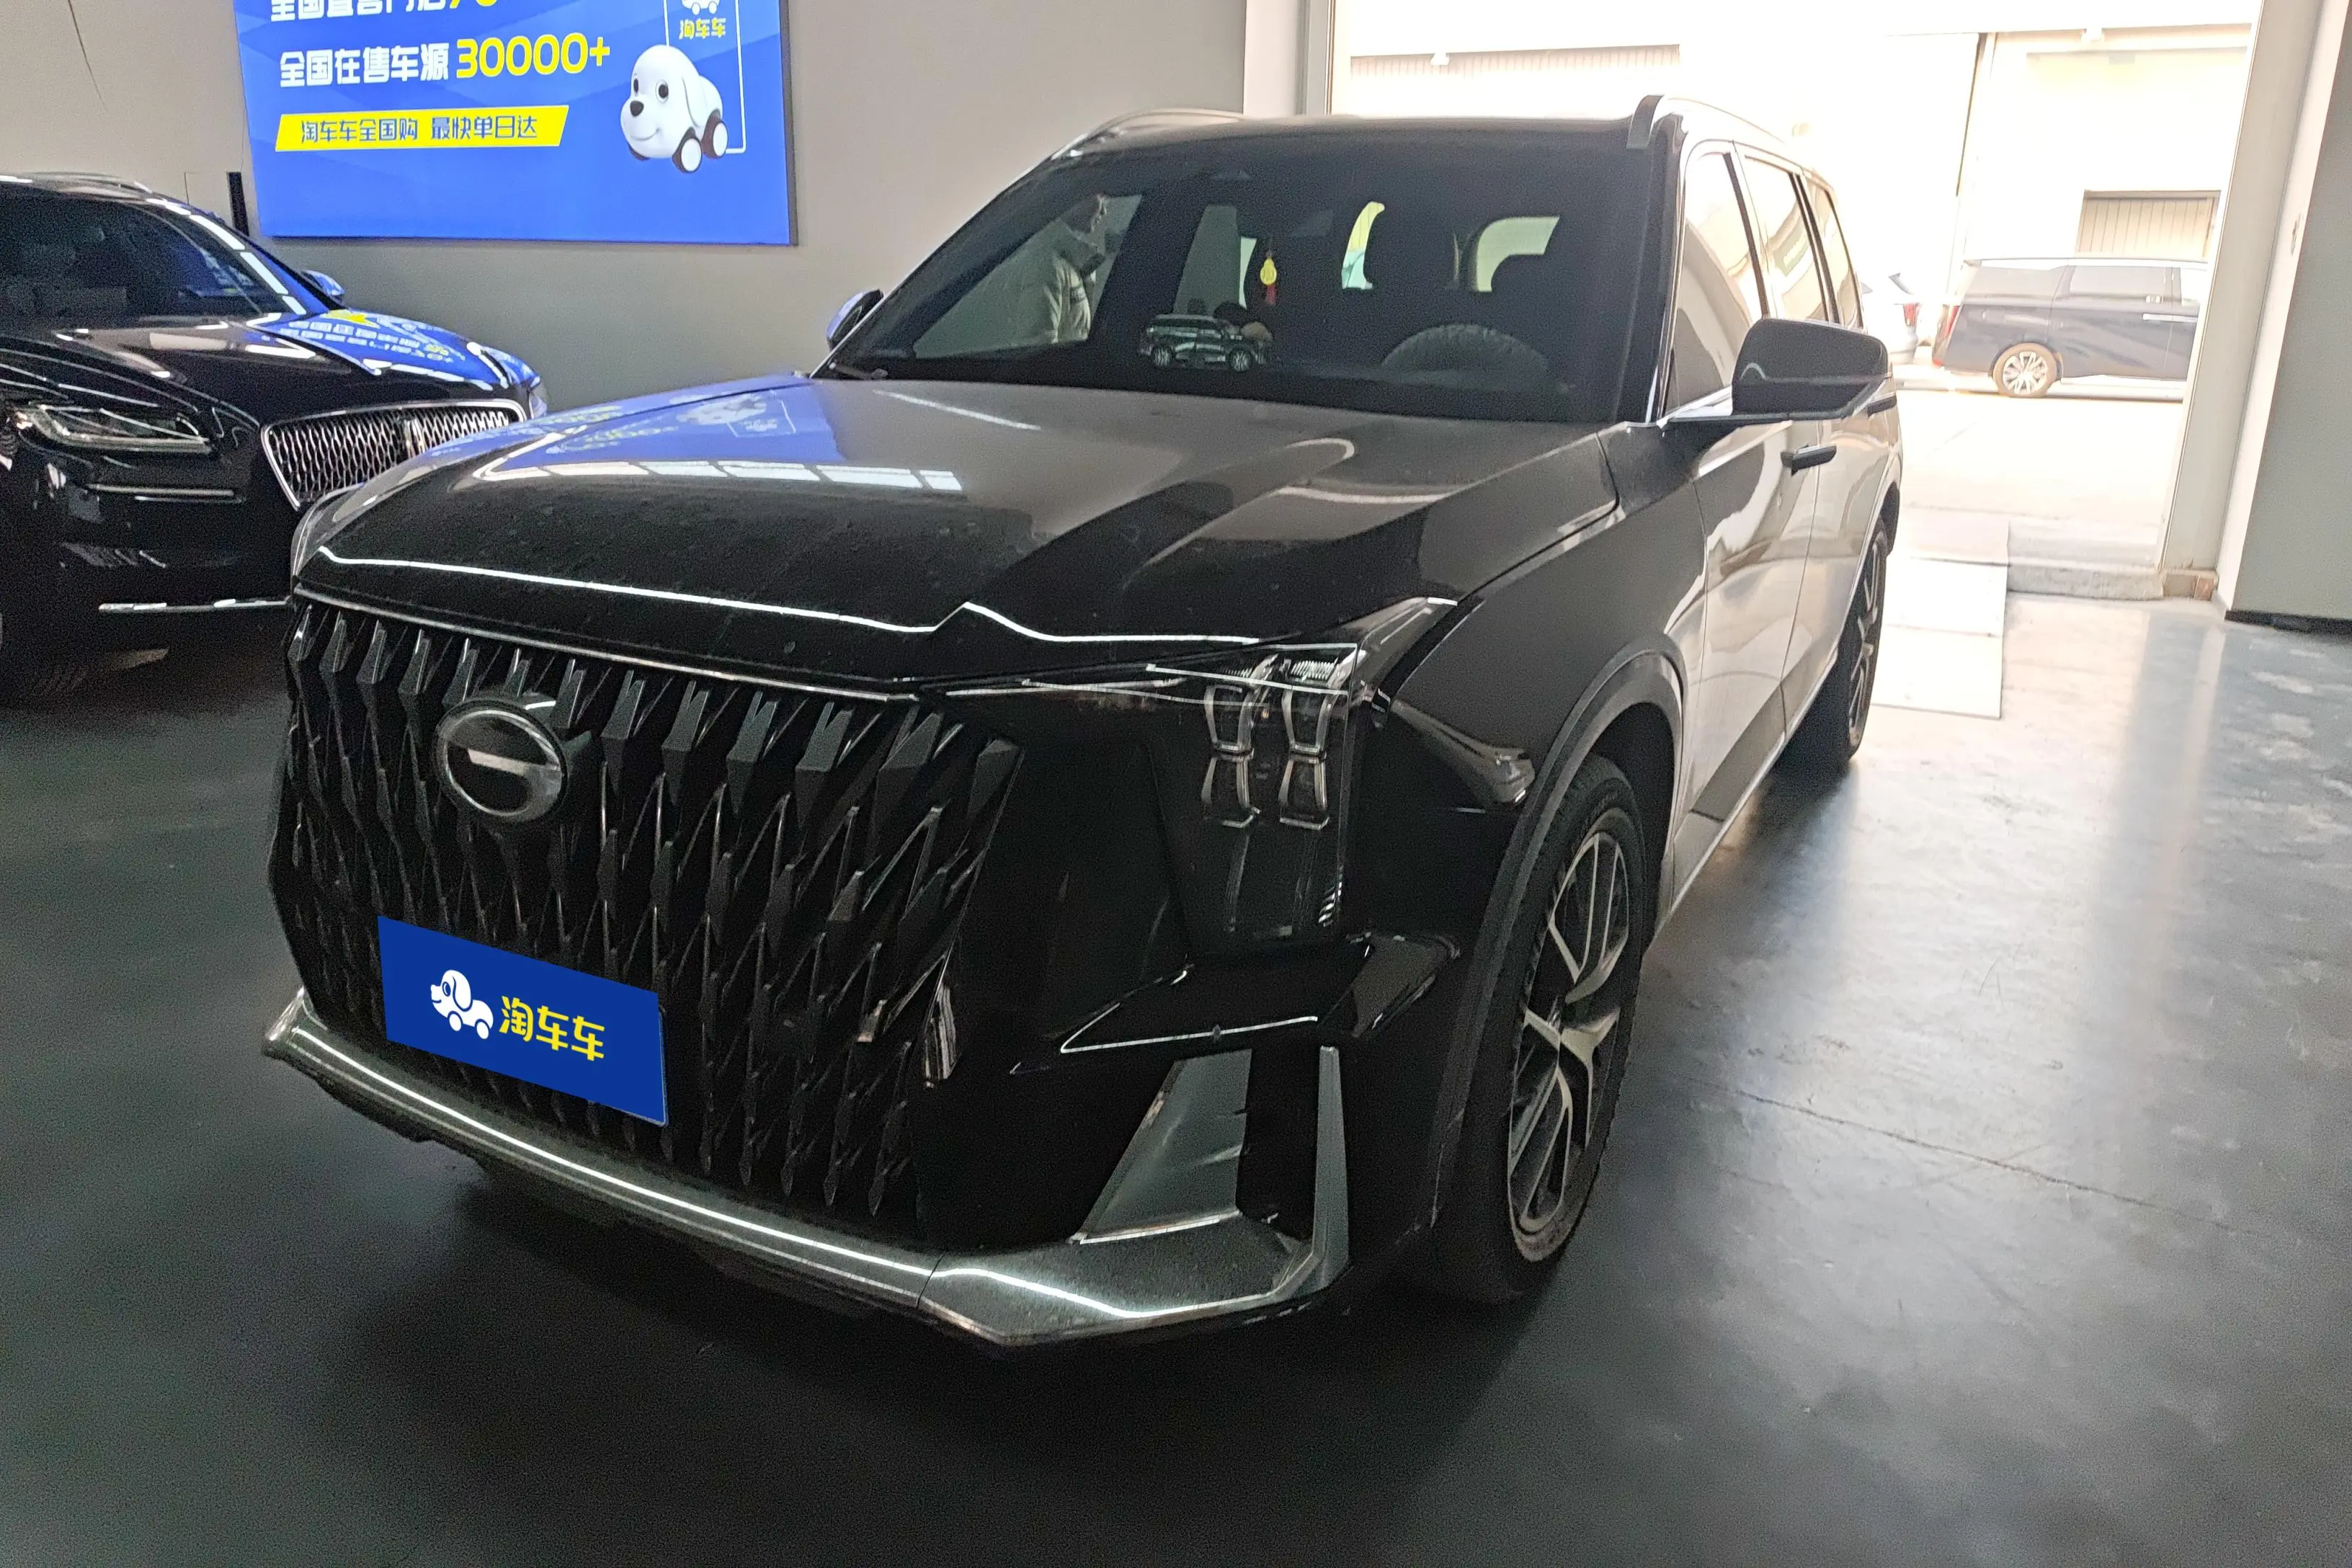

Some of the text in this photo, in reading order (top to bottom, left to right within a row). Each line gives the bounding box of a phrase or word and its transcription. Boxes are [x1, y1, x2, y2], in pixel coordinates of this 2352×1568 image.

[679, 17, 726, 40] 淘车车
[280, 33, 610, 87] 全国在售车源 30000+
[301, 115, 538, 143] 淘车车全国购 最快单日达
